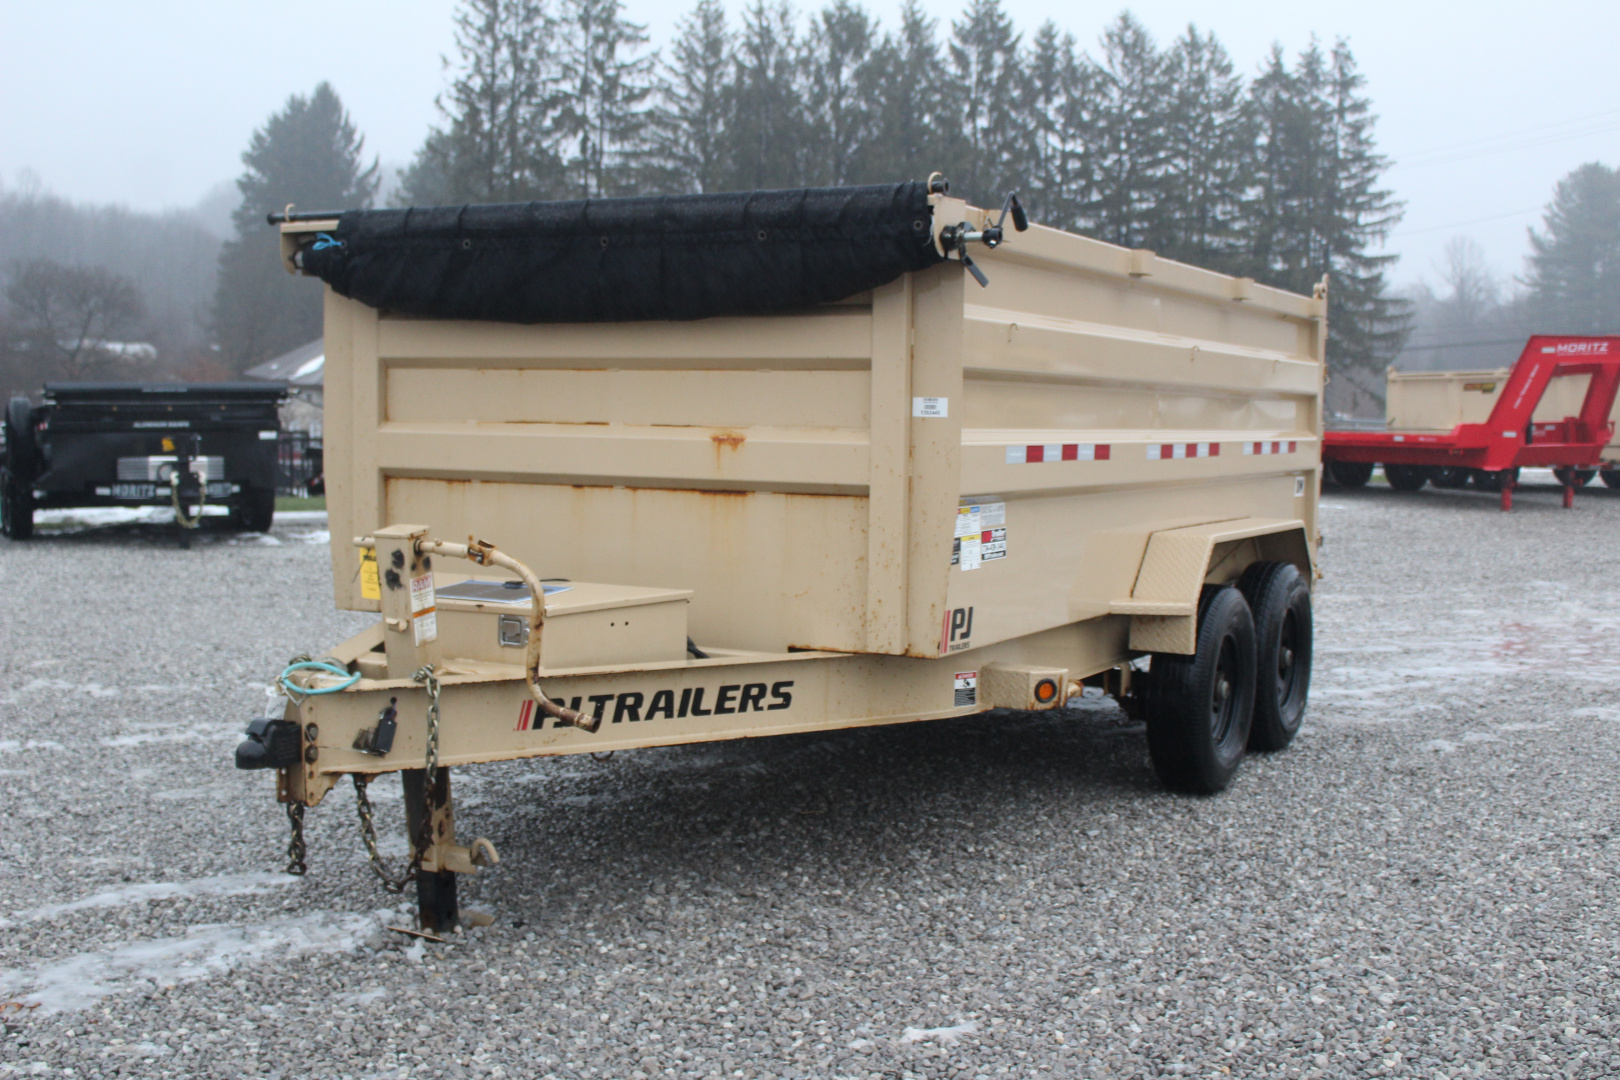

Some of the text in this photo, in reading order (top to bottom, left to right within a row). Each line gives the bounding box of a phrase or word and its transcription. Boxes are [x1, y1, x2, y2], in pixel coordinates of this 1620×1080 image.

[1557, 342, 1609, 353] MORITZ
[112, 484, 155, 498] MORITZ
[950, 606, 974, 642] PJ
[949, 642, 971, 652] TRAILERS
[587, 680, 795, 724] TRAILERS
